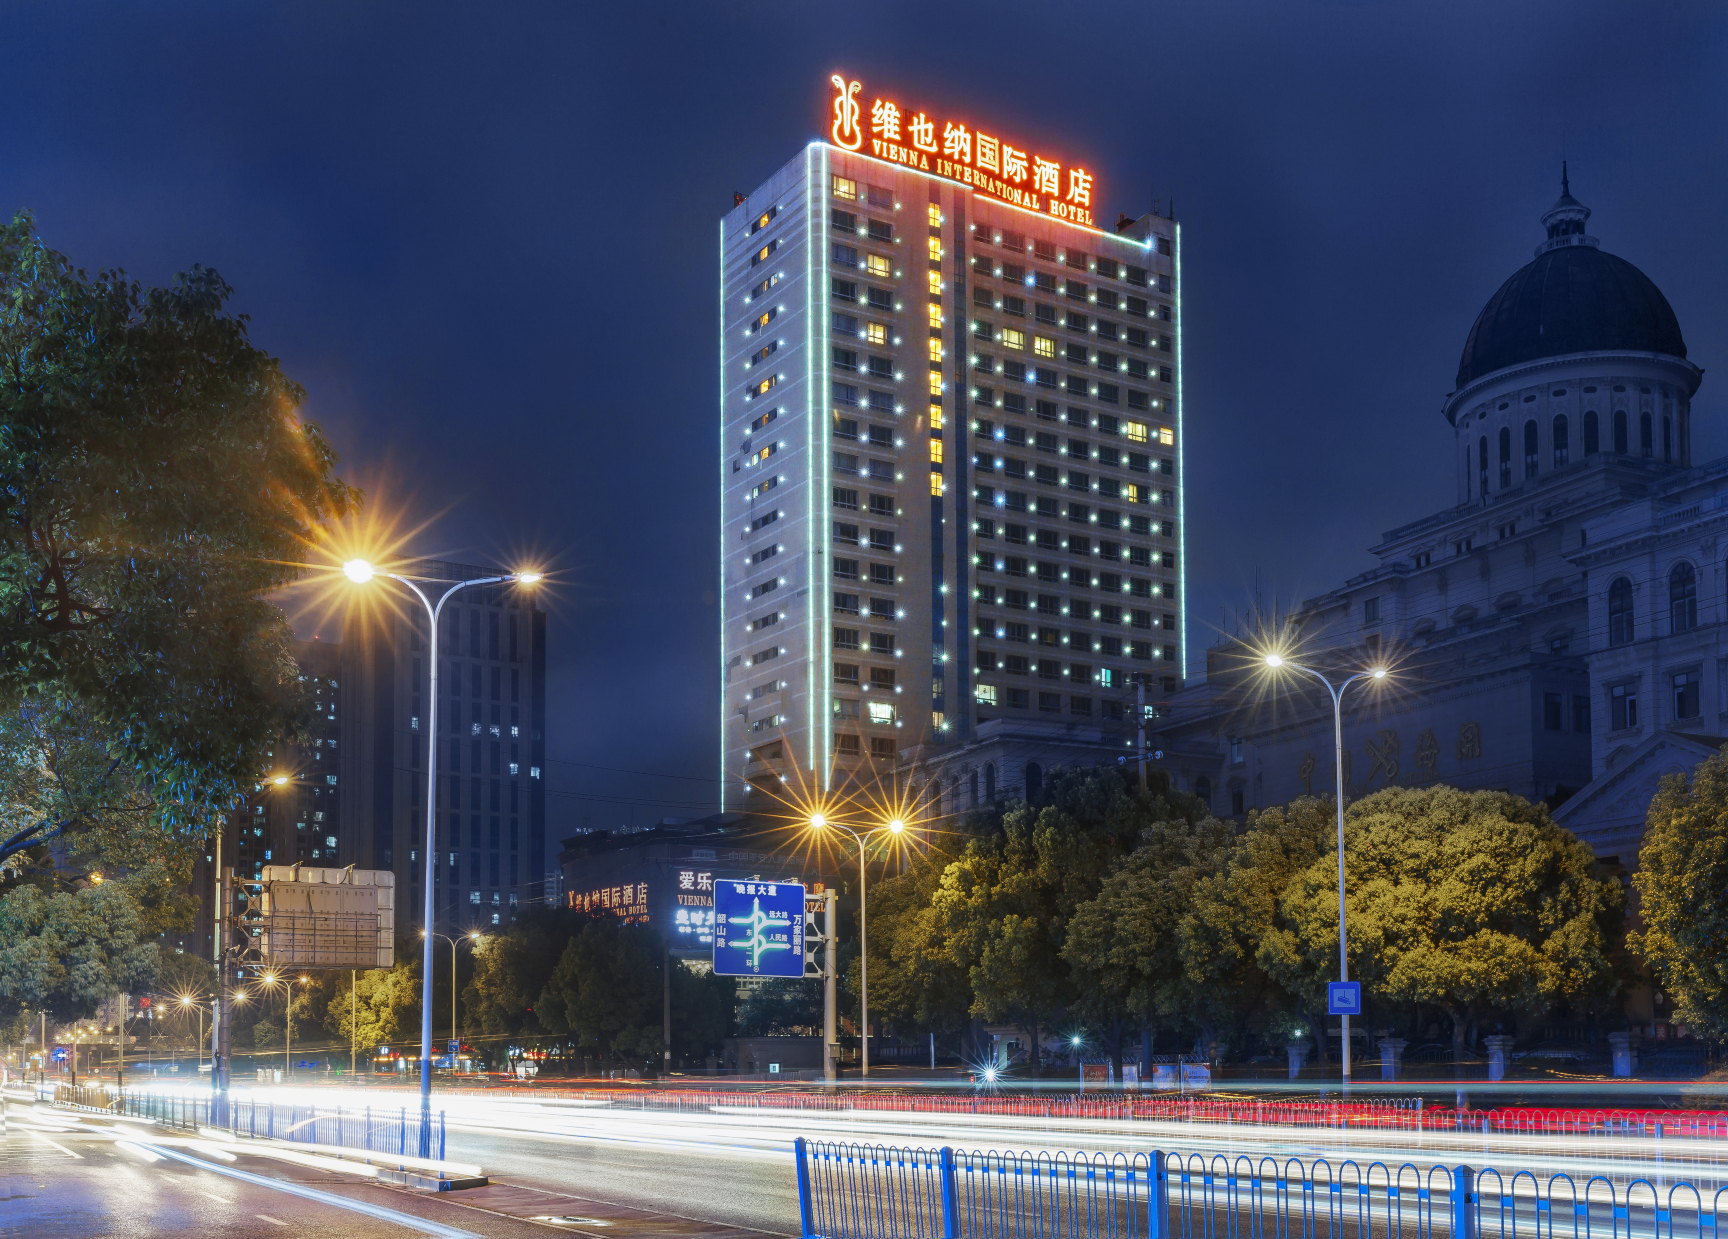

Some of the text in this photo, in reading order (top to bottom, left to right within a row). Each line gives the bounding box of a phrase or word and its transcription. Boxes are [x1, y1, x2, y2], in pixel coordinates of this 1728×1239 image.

[871, 98, 1092, 207] 维也纳国际酒店
[872, 138, 1093, 225] VIENNA INTERNATIONAL HOTEL
[679, 871, 713, 891] 爱乐
[735, 884, 777, 896] 晚报大道
[677, 894, 714, 907] VIENNA
[804, 901, 826, 913] OTEL
[628, 904, 648, 916] HOTEL
[768, 910, 788, 919] 远大路
[716, 913, 727, 948] 韶山路
[768, 933, 788, 943] 人民路
[792, 914, 803, 956] 万家丽路
[745, 928, 753, 968] 东二环
